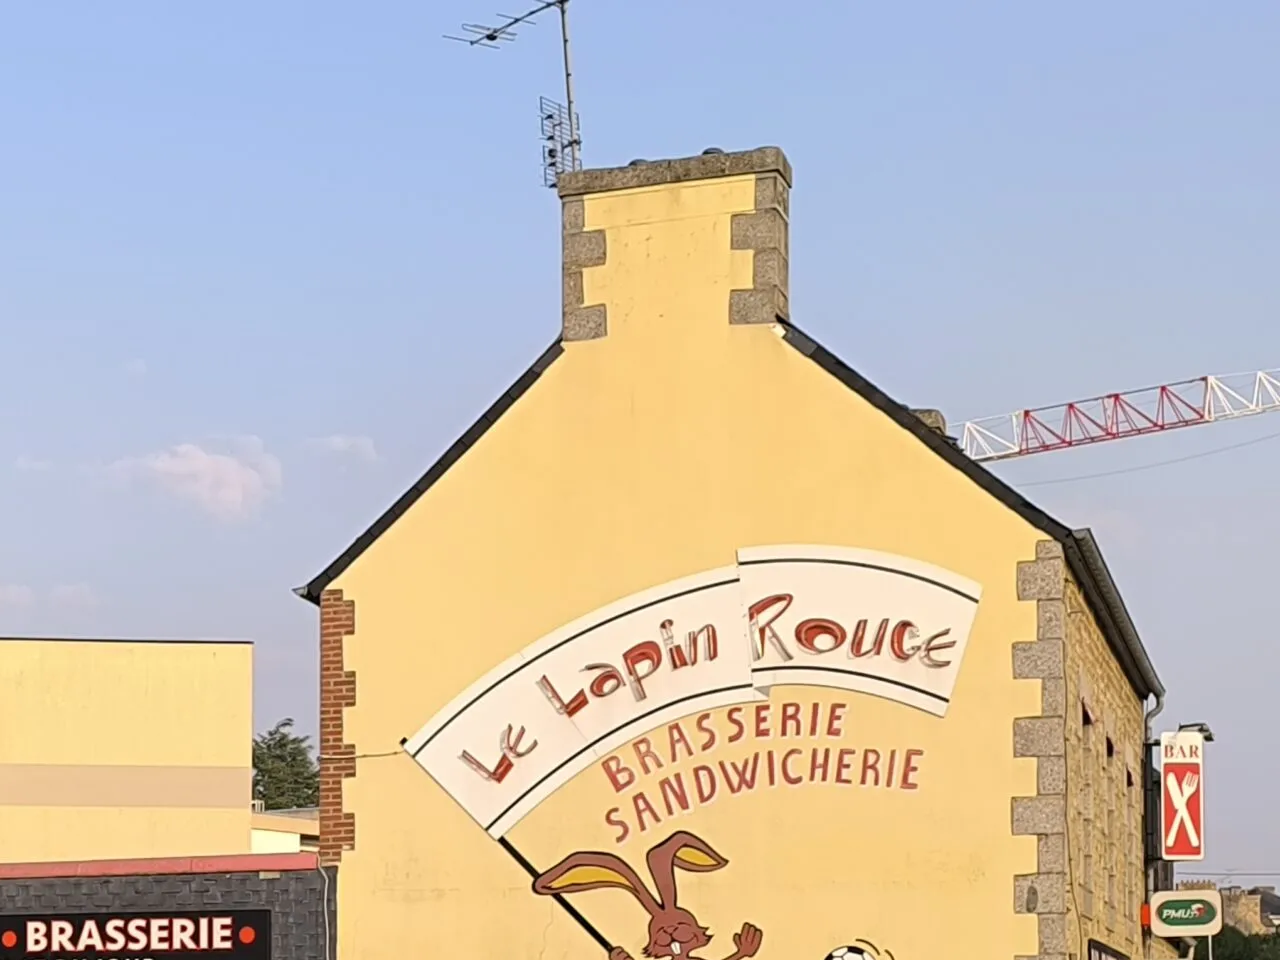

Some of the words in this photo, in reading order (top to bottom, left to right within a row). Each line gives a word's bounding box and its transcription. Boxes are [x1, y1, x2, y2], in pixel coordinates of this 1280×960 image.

[536, 618, 719, 718] Lapin
[600, 701, 849, 794] BRASSERIE
[1164, 744, 1200, 758] BAR
[605, 747, 925, 844] SANDWICHERIE
[26, 917, 234, 953] BRASSERIE
[1162, 908, 1190, 919] PMU
